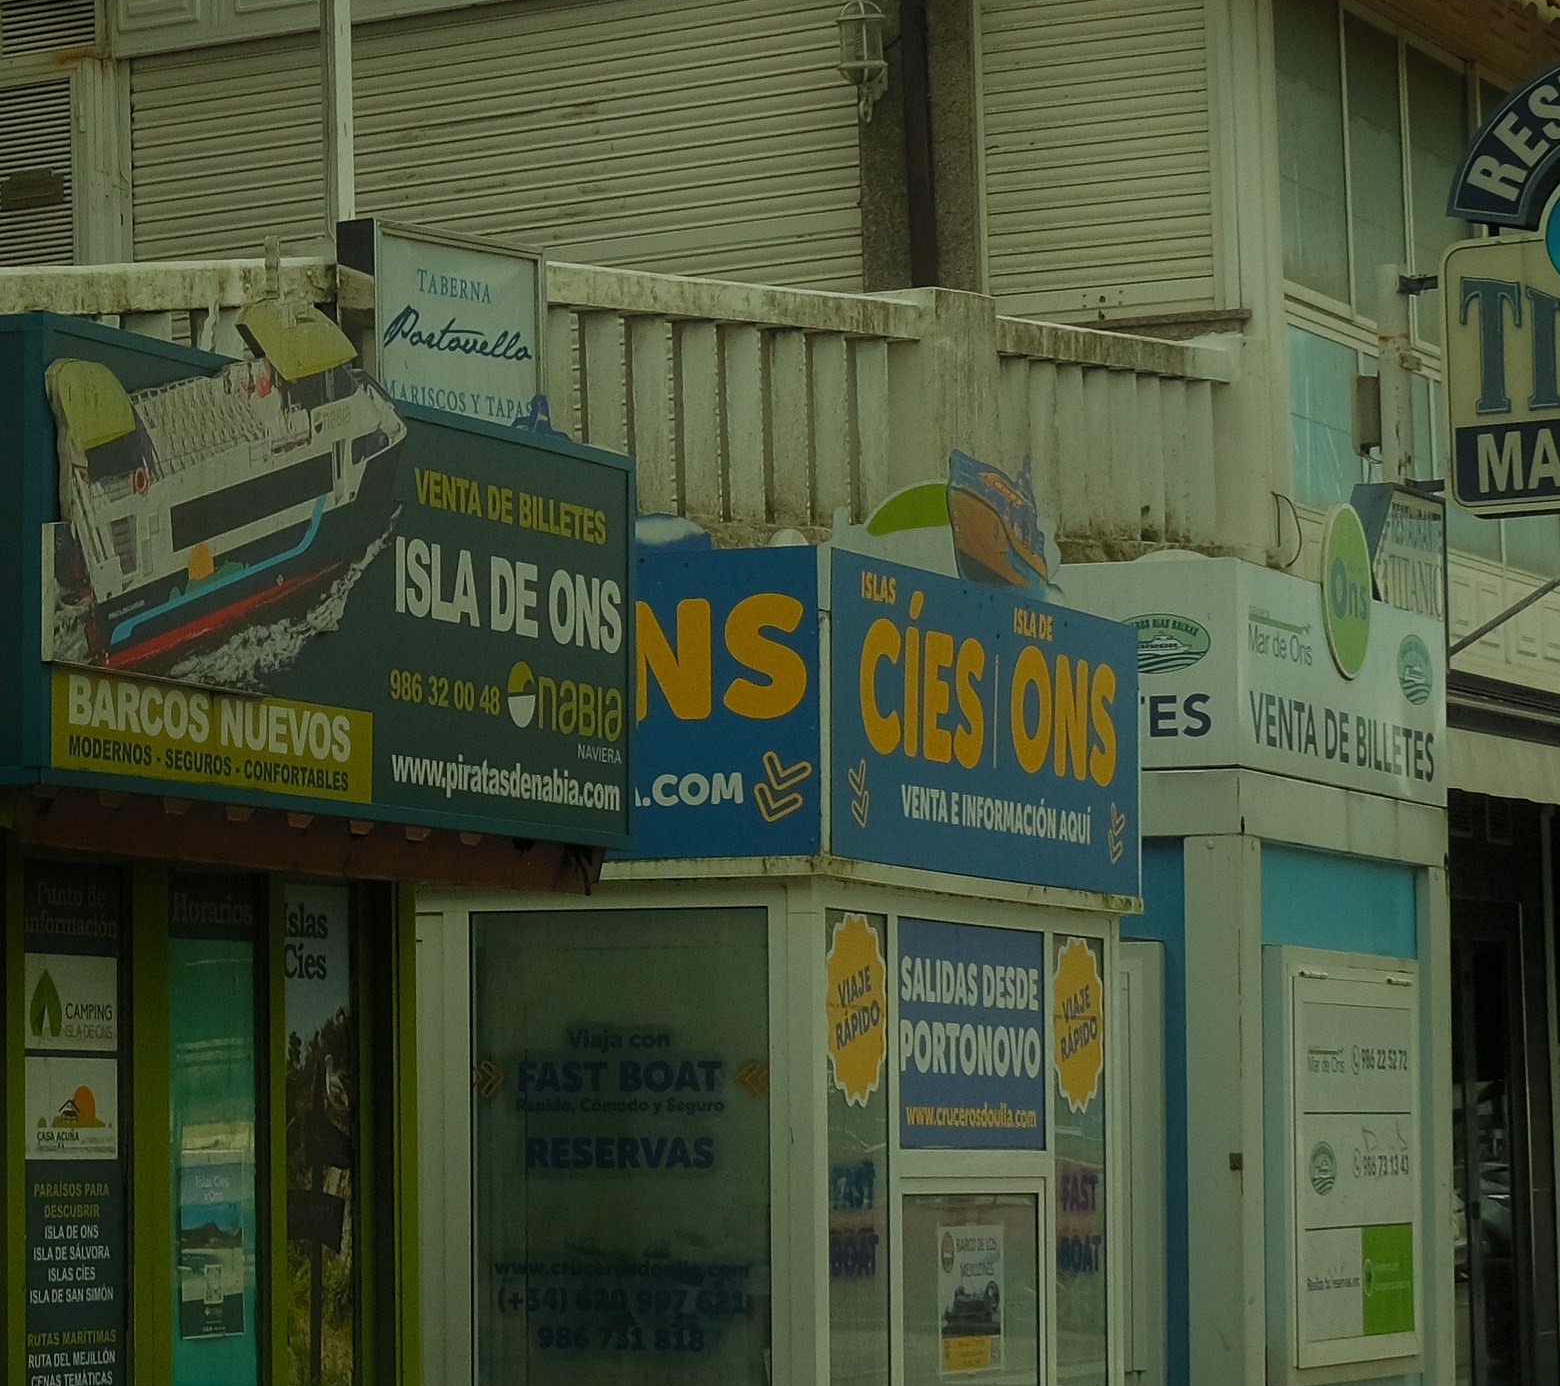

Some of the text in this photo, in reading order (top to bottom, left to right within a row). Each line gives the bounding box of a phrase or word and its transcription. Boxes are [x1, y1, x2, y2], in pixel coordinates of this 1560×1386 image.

[416, 267, 492, 304] TABERNA
[471, 394, 480, 414] Y
[395, 535, 623, 655] ISLA DE ONS
[861, 569, 898, 608] ISLAS
[1334, 556, 1368, 621] Ons
[1013, 607, 1055, 641] ISLA DE
[860, 589, 985, 771] CÍES
[67, 673, 352, 763] BARCOS NUEVOS
[1011, 644, 1118, 789] ONS
[1248, 689, 1436, 784] VENTA DE BILLETES
[68, 734, 349, 794] MODERNOS SEGUROS CONFORTABLES
[391, 753, 622, 812] www.piratasdenabia.com
[900, 784, 1092, 846] VENTA E INFORMACIÓN AQUÍ
[837, 965, 873, 1009] VIAJE
[900, 954, 1041, 1013] SALIDAS DESDE
[65, 1002, 113, 1022] CAMPING
[834, 999, 882, 1052] RÁPIDO
[567, 1028, 672, 1054] Viaja con
[899, 1018, 1042, 1081] PORTONOVO
[516, 1060, 725, 1094] FAST BOAT
[525, 1136, 716, 1170] RESERVAS
[28, 1347, 116, 1369] RUTA DEL MEJILLÓN
